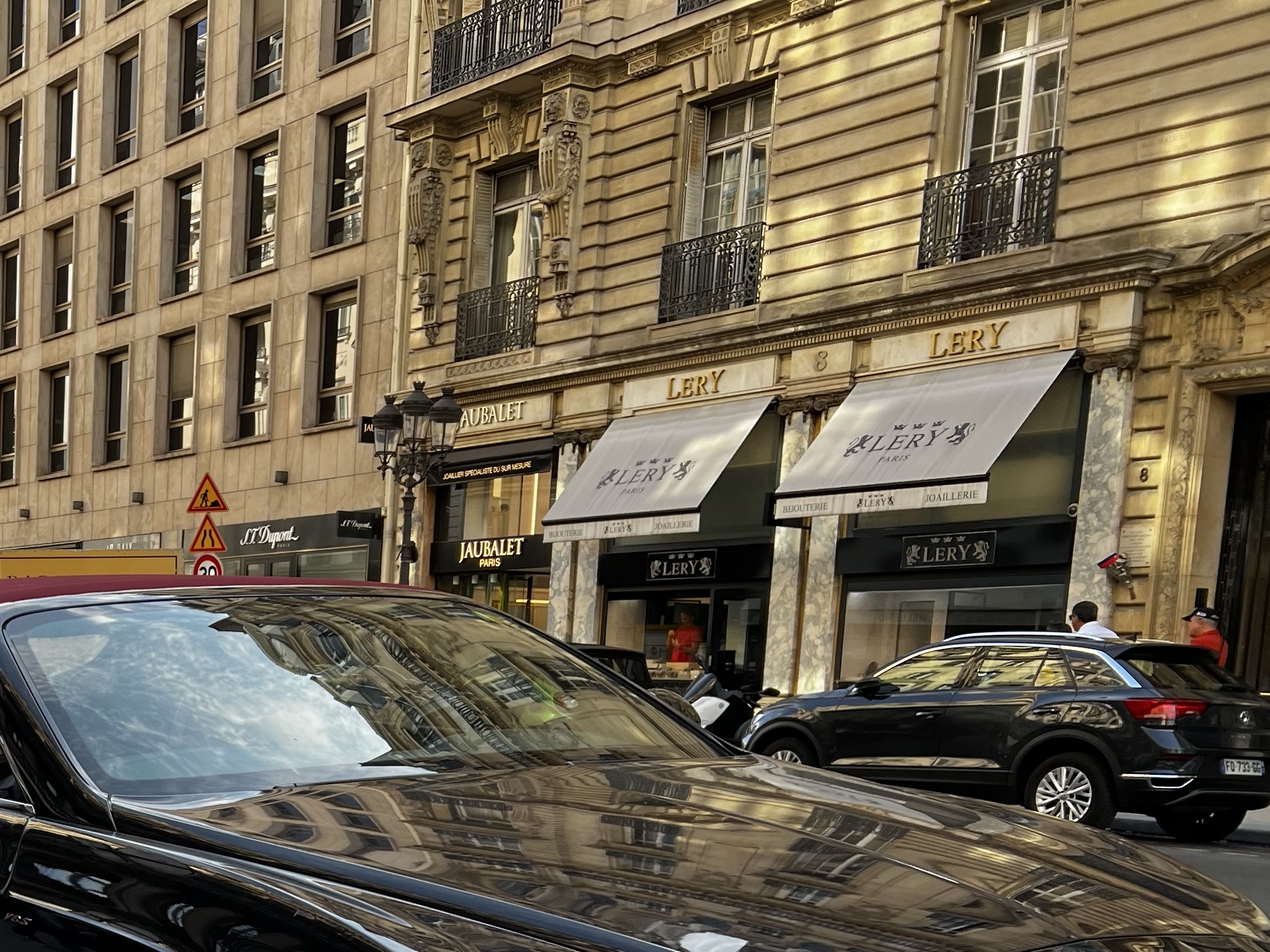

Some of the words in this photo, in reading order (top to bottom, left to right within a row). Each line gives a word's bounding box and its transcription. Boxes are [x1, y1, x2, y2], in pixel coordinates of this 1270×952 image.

[929, 320, 1010, 359] LERY
[813, 350, 828, 372] 8
[666, 368, 725, 400] LERY
[457, 400, 526, 429] AUBALET
[866, 426, 952, 453] LERY
[877, 454, 911, 464] PARIS
[614, 464, 677, 486] LERY
[1139, 467, 1149, 482] 8
[620, 486, 646, 495] PARIS
[782, 501, 828, 514] BIJOUTERIE
[864, 497, 887, 508] LERY
[925, 489, 979, 503] JOAILLERIE
[257, 524, 300, 550] Dupont
[548, 528, 584, 539] BIJOUTERIE
[609, 525, 626, 534] LERY
[654, 520, 694, 531] JOAILLERIE
[458, 537, 525, 564] JAUBALET
[923, 543, 973, 563] LERY
[479, 557, 501, 568] PARIS
[662, 559, 700, 576] LERY
